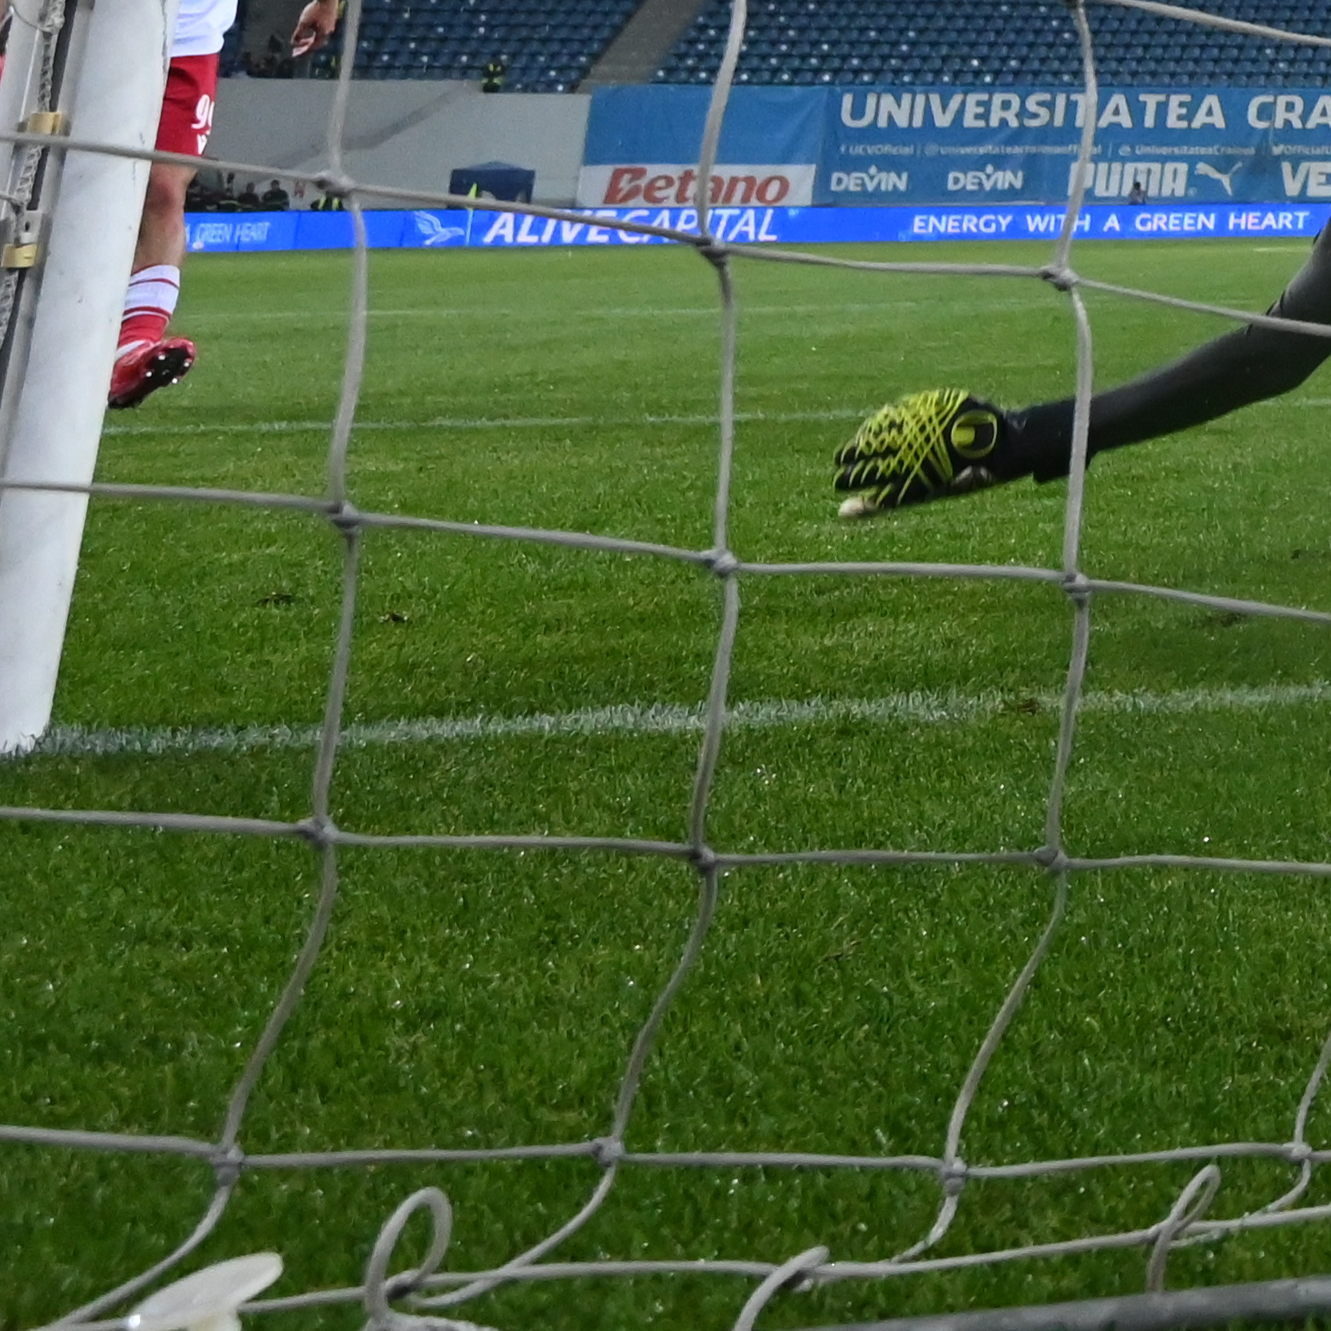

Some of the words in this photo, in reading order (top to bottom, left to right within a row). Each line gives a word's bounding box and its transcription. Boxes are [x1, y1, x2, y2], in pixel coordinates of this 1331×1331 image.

[840, 92, 1226, 129] UNIVERSITATEA
[603, 167, 790, 205] Betano
[830, 166, 908, 192] DEVIN
[947, 165, 1023, 191] DEVIN
[1068, 161, 1188, 197] PUMA
[913, 214, 1013, 233] ENERGY
[1103, 214, 1120, 232] A
[1135, 213, 1216, 231] GREEN
[1229, 211, 1310, 230] HEART
